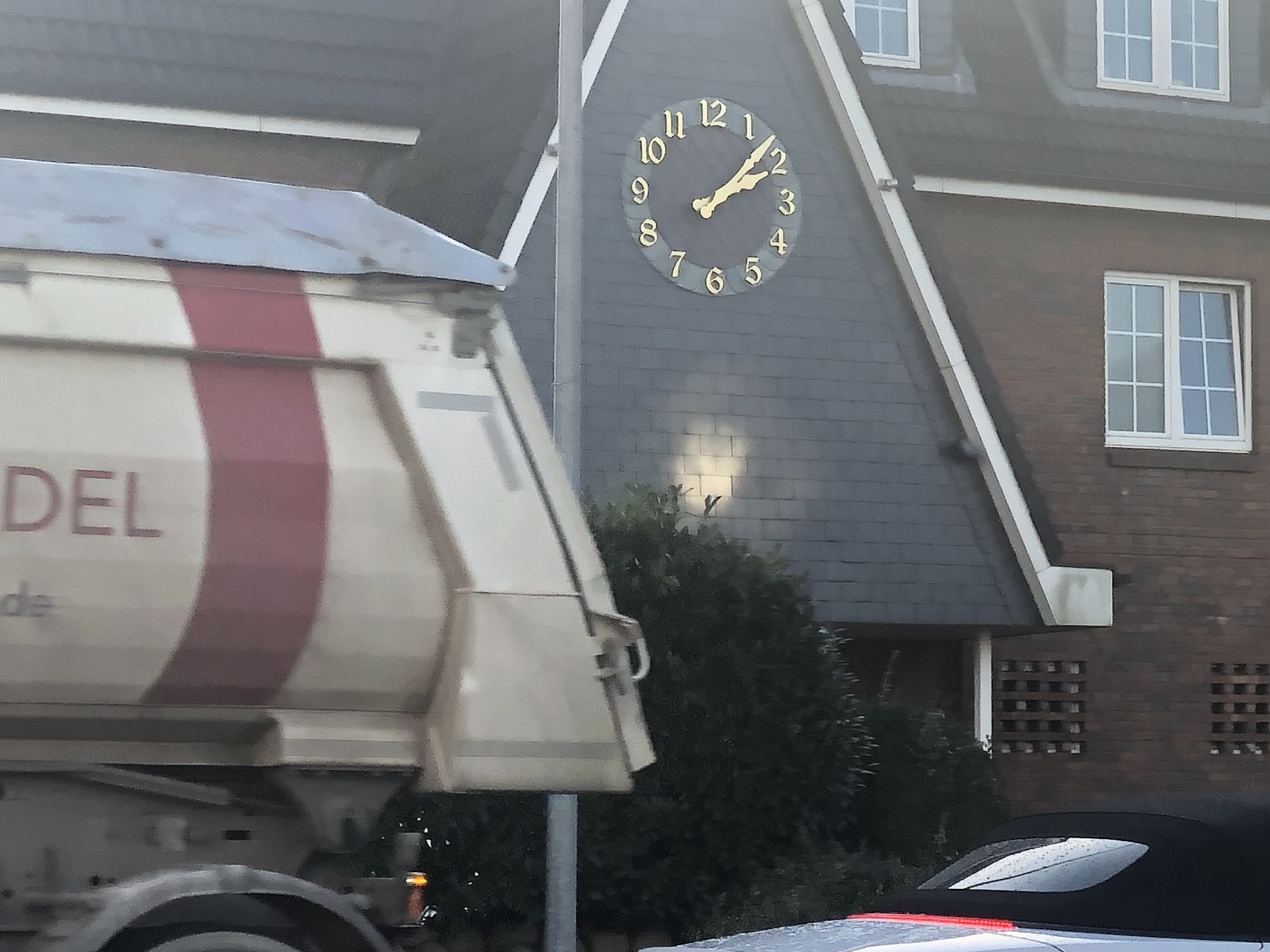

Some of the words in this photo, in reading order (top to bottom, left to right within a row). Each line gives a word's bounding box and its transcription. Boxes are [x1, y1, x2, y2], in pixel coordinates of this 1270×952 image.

[664, 110, 686, 139] 11
[700, 99, 727, 128] 12
[744, 113, 755, 141] 1
[639, 136, 666, 164] 10
[770, 148, 788, 175] 2
[631, 177, 649, 205] 9
[778, 188, 796, 216] 3
[639, 218, 658, 247] 8
[769, 228, 788, 256] 4
[669, 250, 687, 278] 7
[745, 257, 762, 285] 5
[705, 266, 724, 295] 6
[4, 465, 164, 538] DEL
